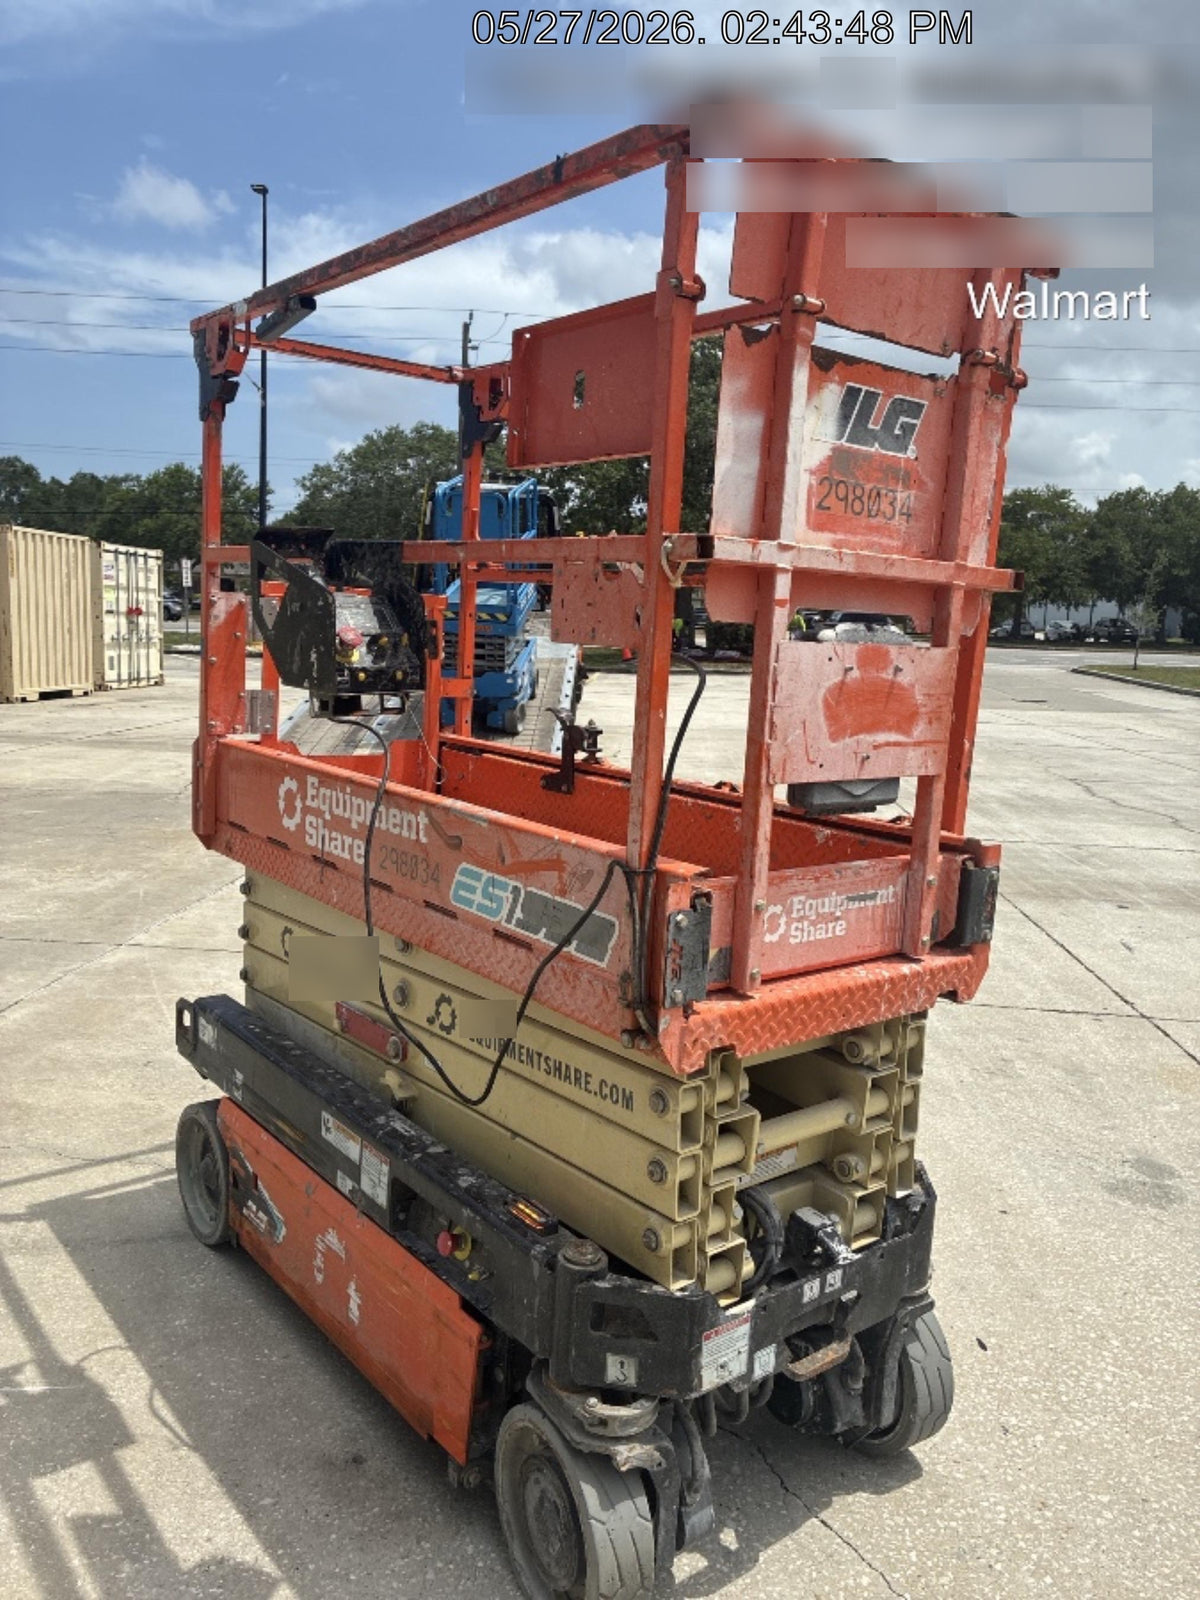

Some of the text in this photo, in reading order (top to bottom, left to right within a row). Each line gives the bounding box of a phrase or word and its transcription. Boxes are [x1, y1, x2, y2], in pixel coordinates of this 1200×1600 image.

[816, 476, 913, 524] 298034
[306, 774, 430, 844] Equipment
[304, 813, 366, 865] Share
[788, 919, 848, 945] Share
